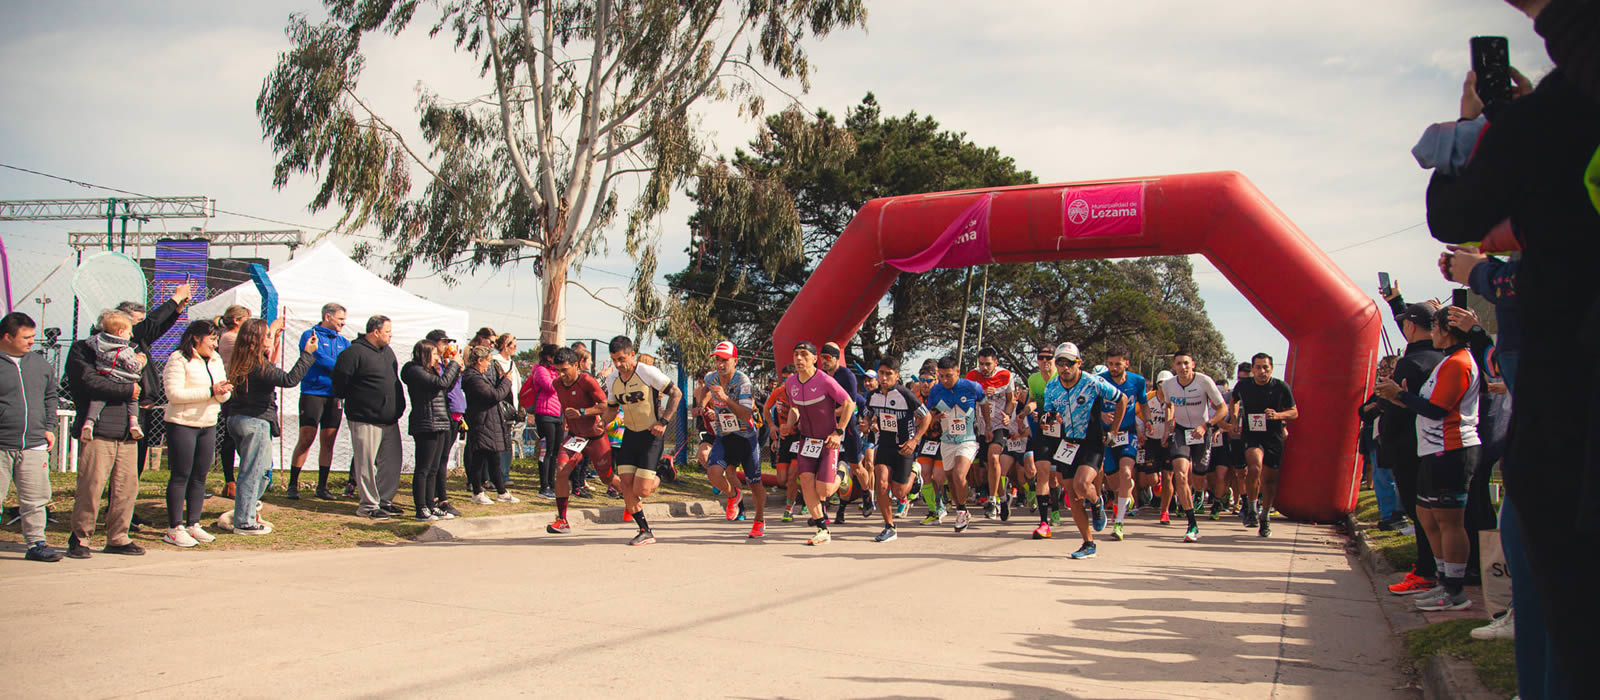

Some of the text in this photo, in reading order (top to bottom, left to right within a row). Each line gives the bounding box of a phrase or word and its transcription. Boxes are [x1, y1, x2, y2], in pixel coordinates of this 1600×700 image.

[722, 420, 737, 428] 161
[951, 423, 965, 431] 189
[805, 445, 821, 454] 137
[1061, 448, 1073, 458] 77
